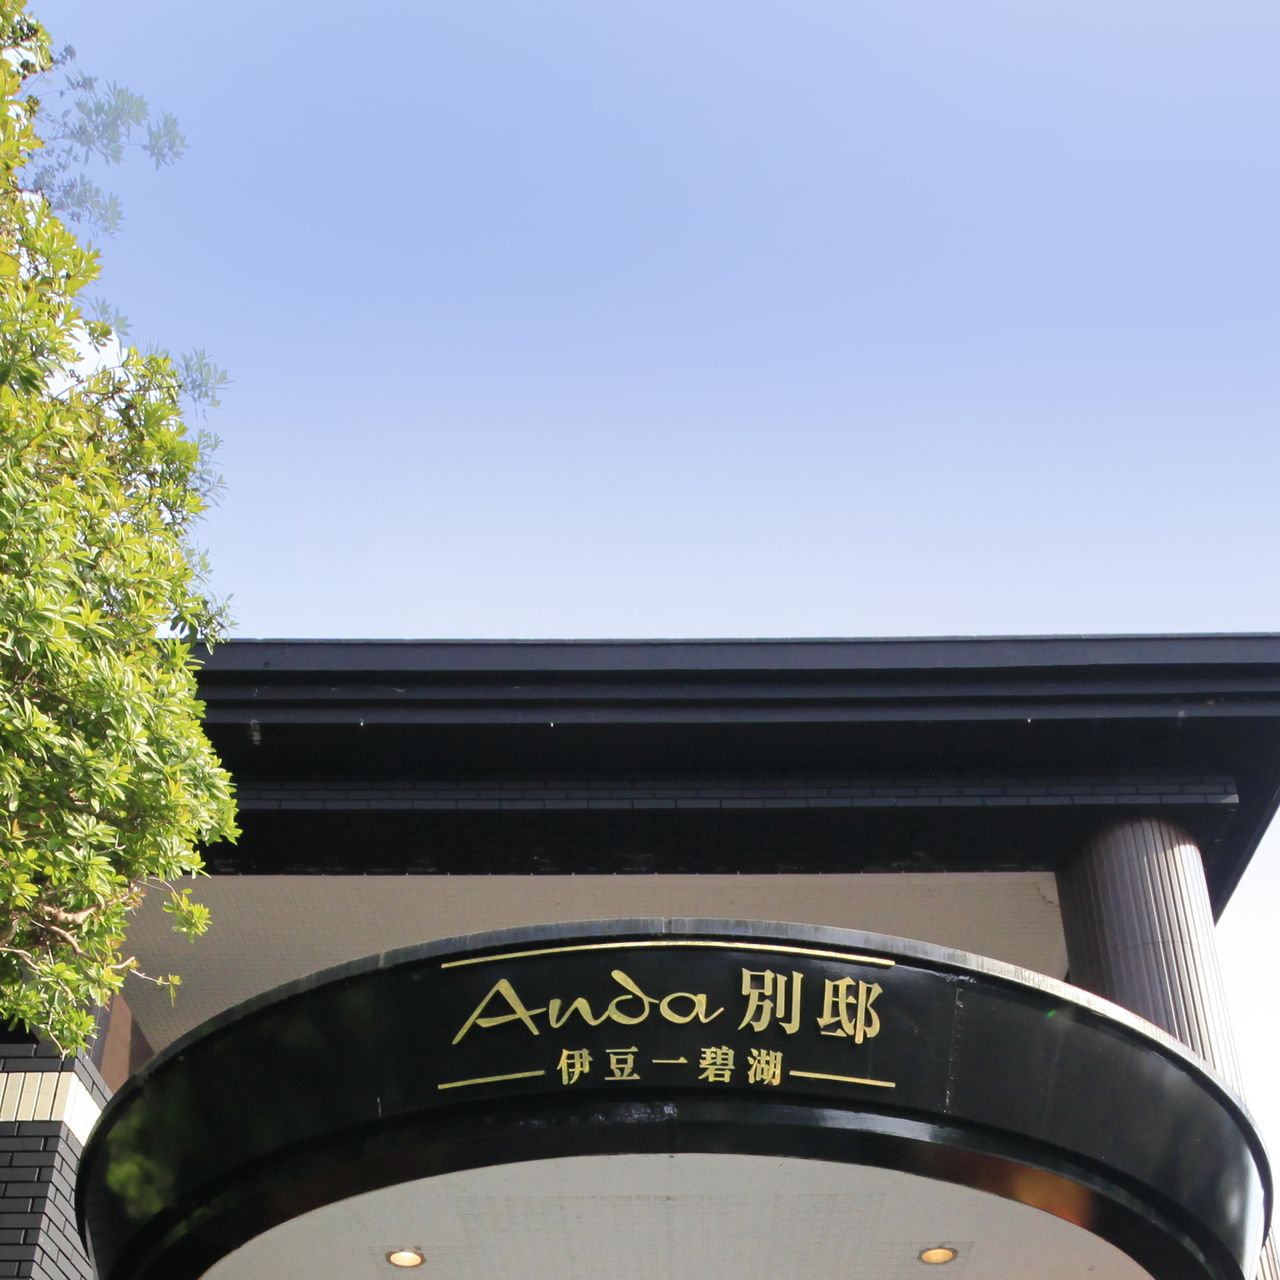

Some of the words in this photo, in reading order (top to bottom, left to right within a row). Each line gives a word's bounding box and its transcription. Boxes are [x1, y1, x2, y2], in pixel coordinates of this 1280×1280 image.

[452, 969, 724, 1045] Anda
[738, 967, 883, 1045] 別邸
[556, 1046, 784, 1086] 伊豆一碧湖
